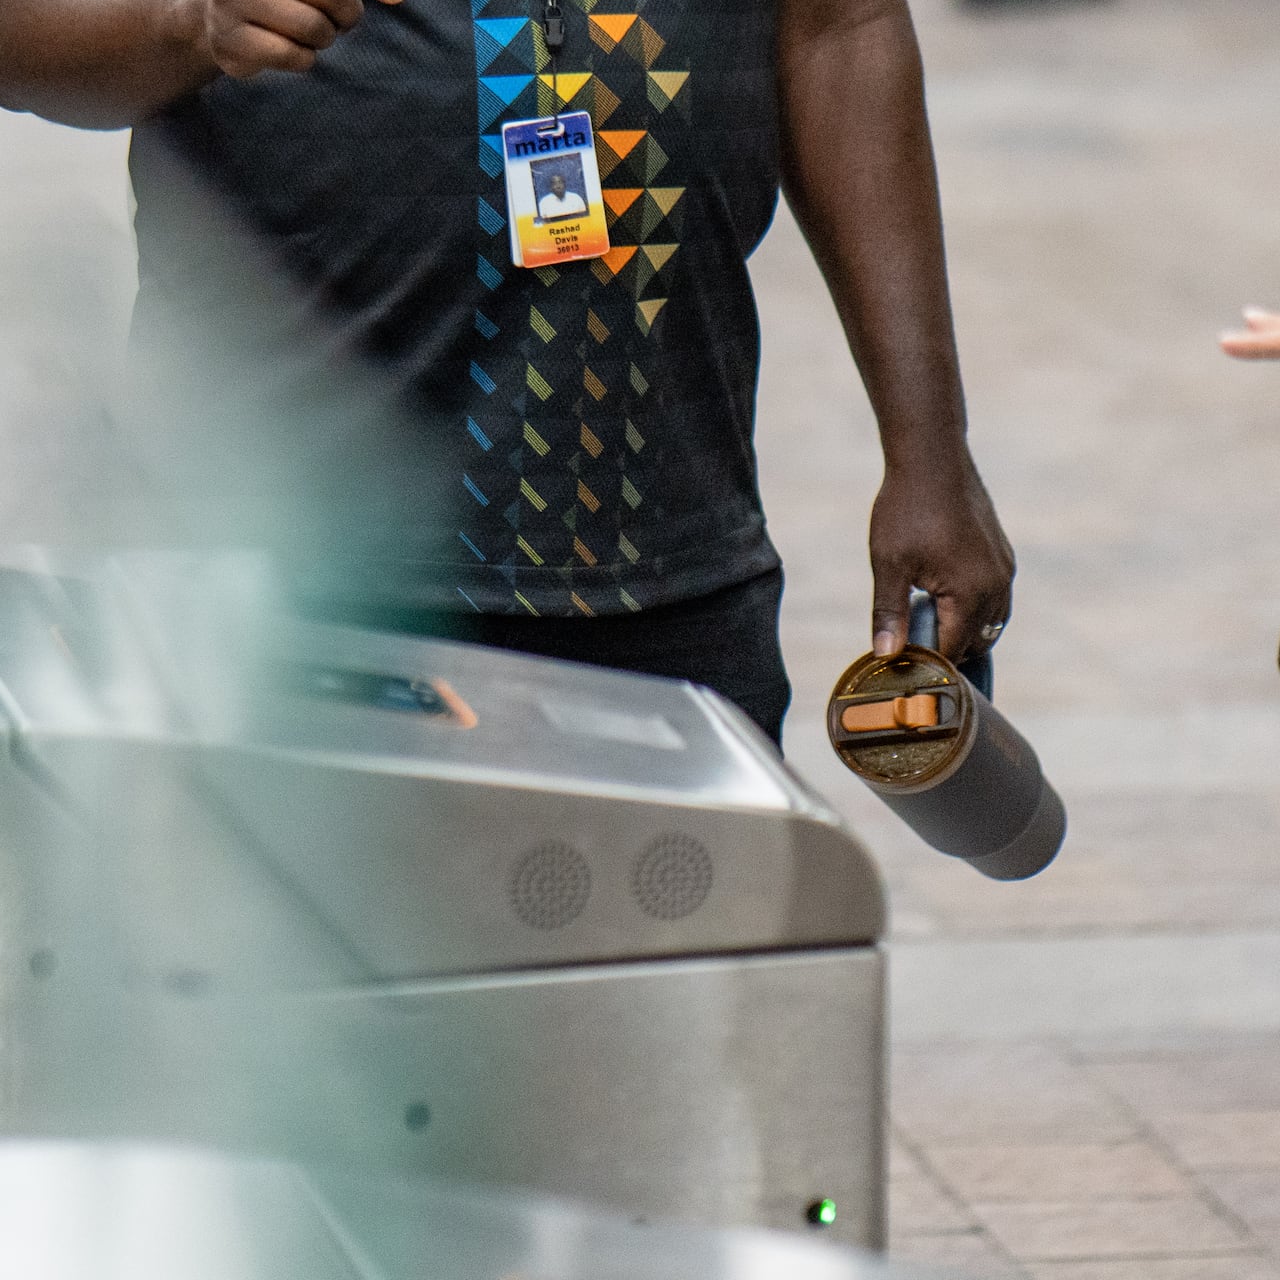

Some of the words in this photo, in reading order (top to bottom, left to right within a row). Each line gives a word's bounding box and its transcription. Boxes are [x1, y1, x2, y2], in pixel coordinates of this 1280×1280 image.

[515, 131, 586, 156] marta
[549, 223, 581, 236] Rashad
[555, 234, 578, 245] Davis
